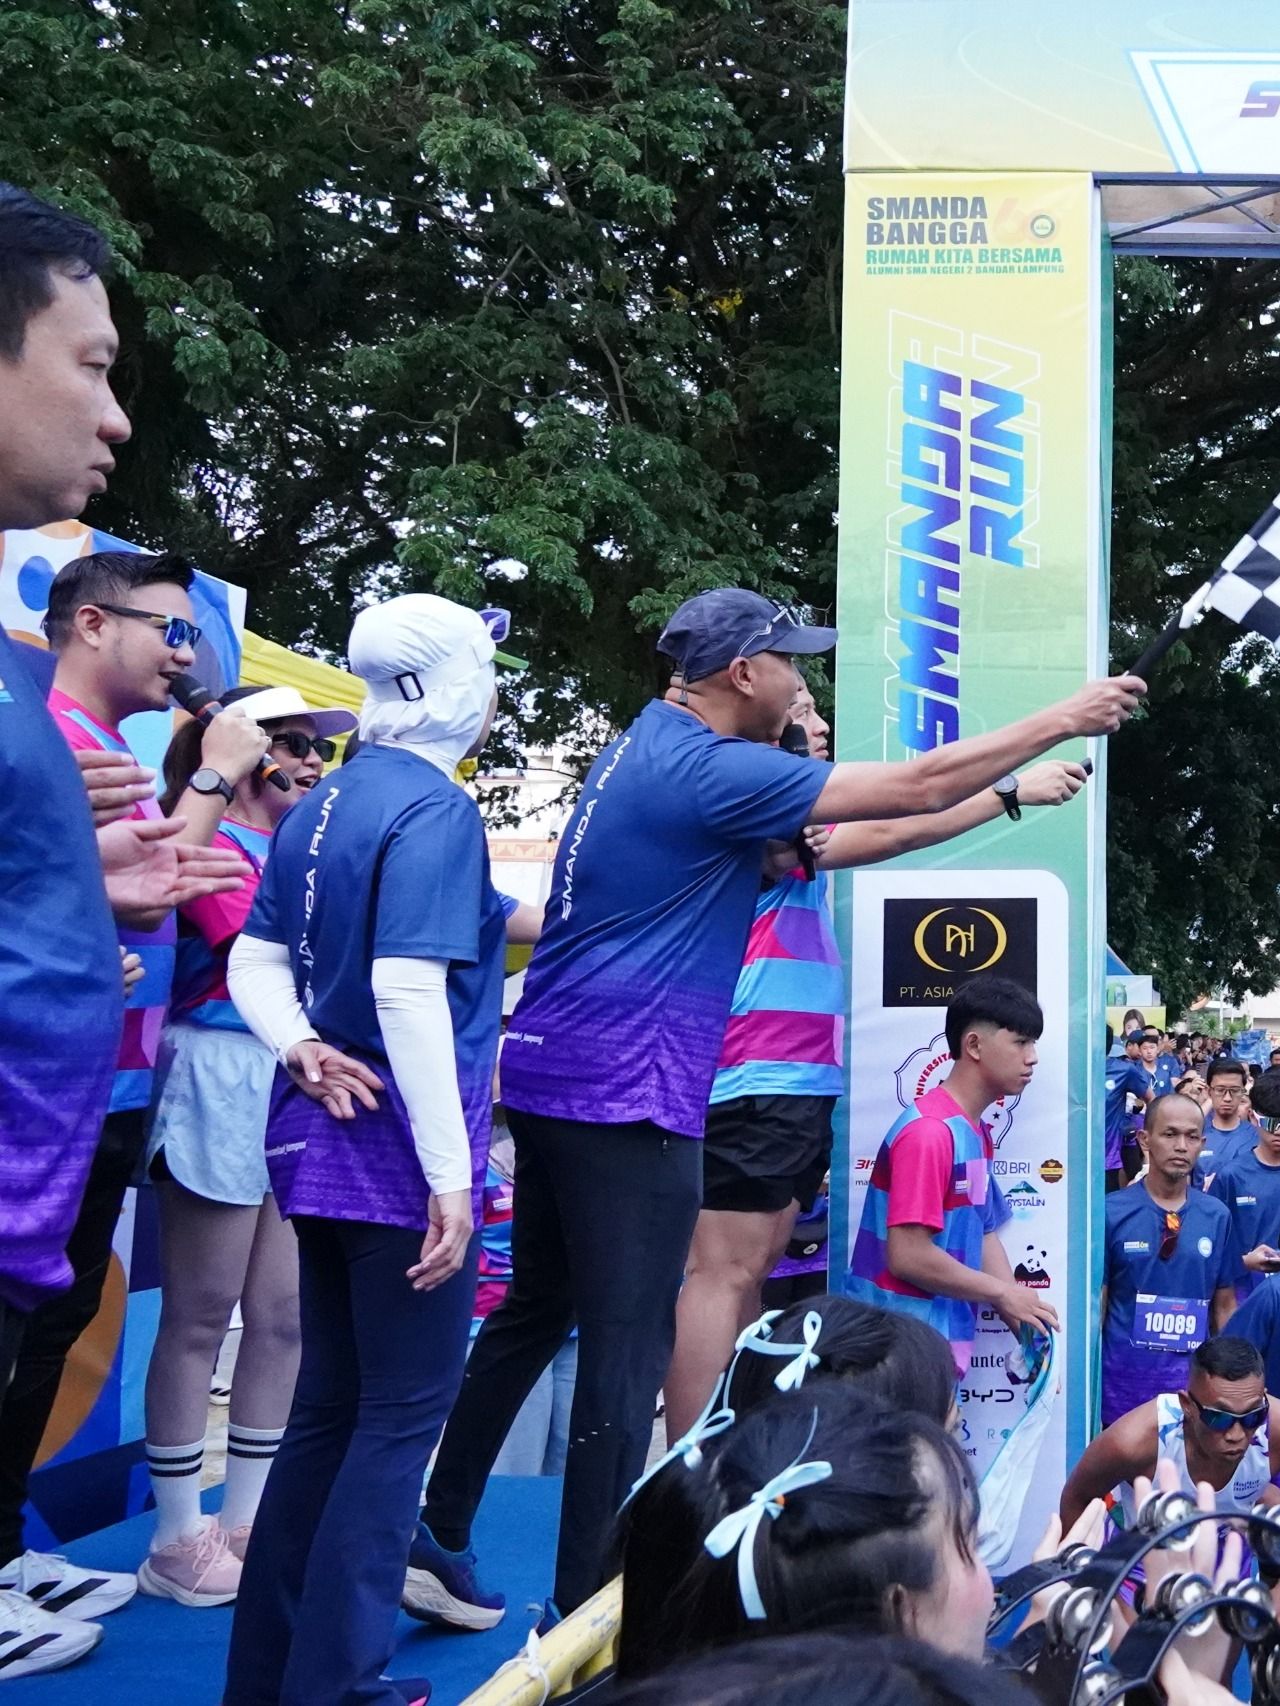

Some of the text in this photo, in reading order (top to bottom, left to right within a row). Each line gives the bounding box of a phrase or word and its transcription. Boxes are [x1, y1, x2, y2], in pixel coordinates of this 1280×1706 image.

[867, 196, 988, 220] SMANDA
[866, 221, 988, 246] BANGGA
[866, 247, 1063, 265] RUMAH KITA BERSAMA
[866, 264, 1065, 276] ALUMNI SMA NEGERI 2 BANDAR LAMPUNG
[900, 360, 1024, 752] SMANDA RUN
[309, 787, 340, 857] RUN
[561, 736, 632, 921] SMANDA RUN
[900, 986, 954, 998] PT. ASIA
[914, 1052, 953, 1100] NIVERSITA
[1009, 1161, 1030, 1174] BRI
[1027, 1279, 1049, 1288] panda
[1145, 1311, 1197, 1335] 10089
[960, 1389, 1015, 1403] BYD
